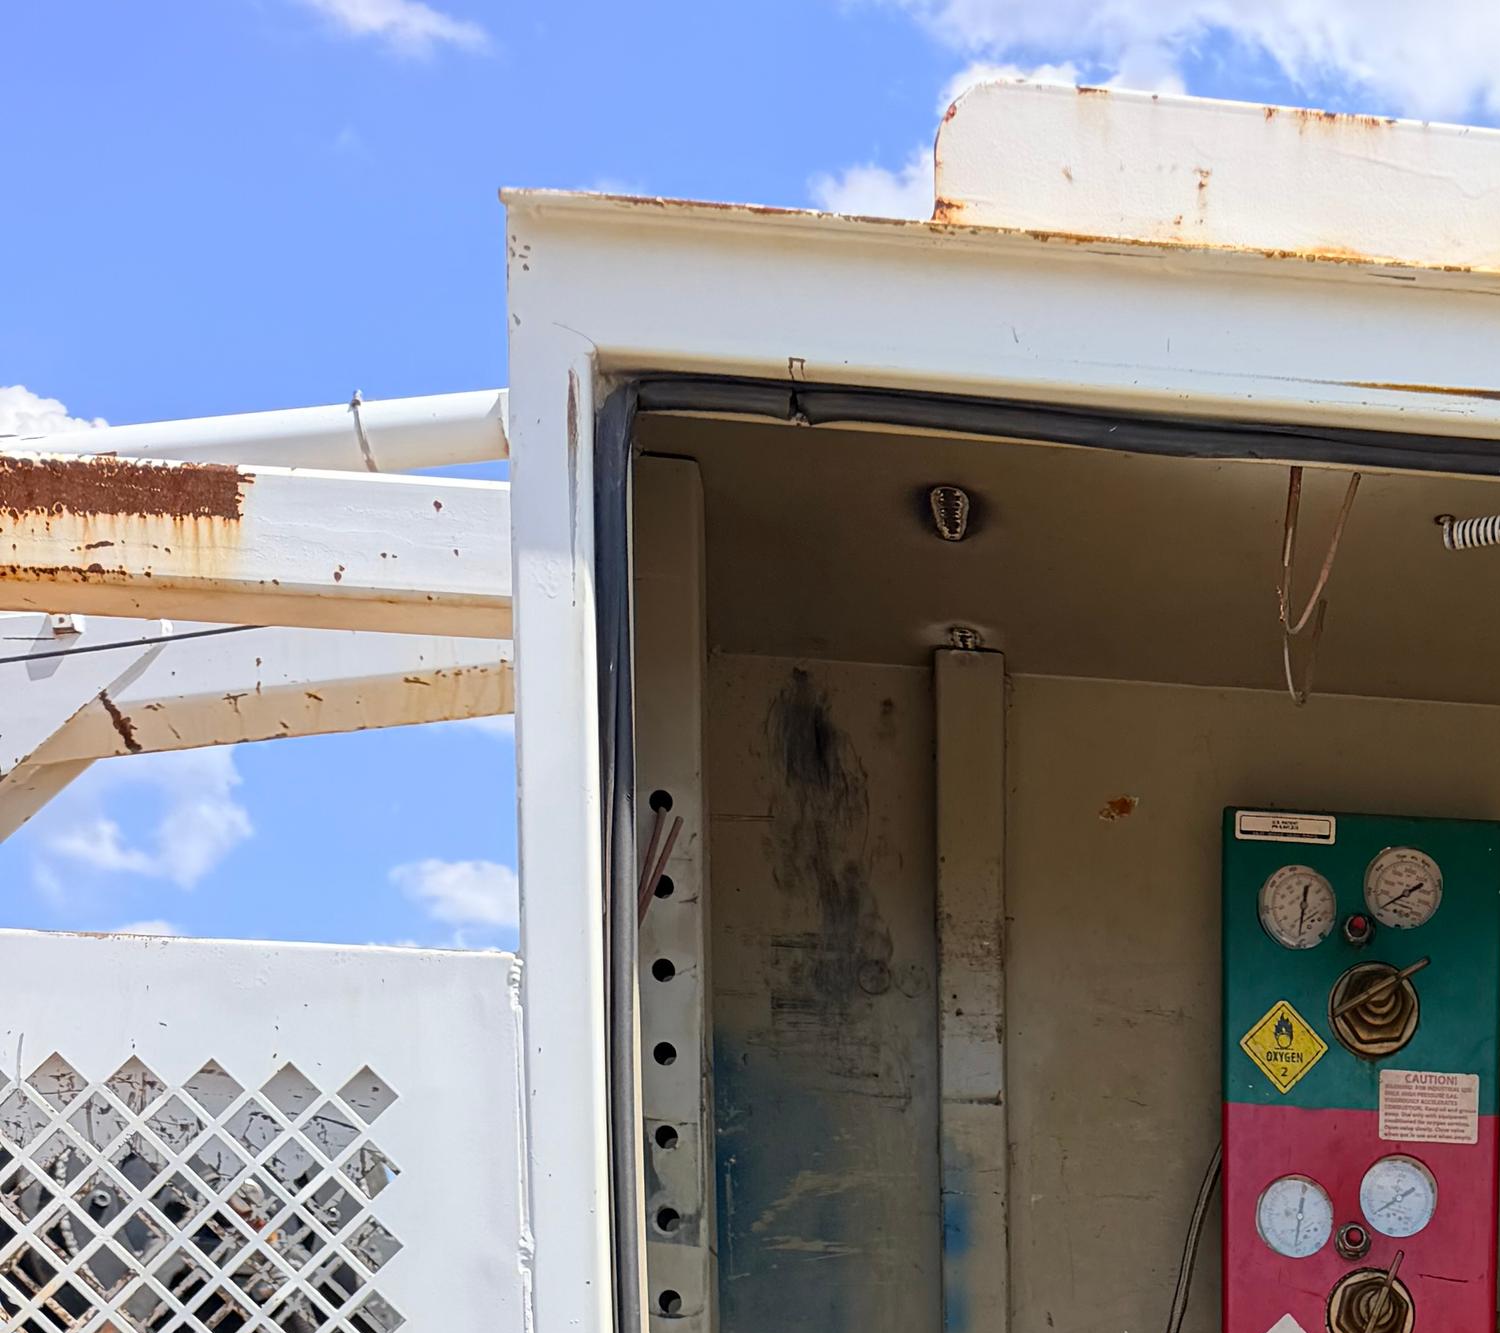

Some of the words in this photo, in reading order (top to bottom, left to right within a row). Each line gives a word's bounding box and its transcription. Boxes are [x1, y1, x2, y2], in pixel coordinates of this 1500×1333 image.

[1266, 1051, 1304, 1063] OXYGEN
[1281, 1067, 1289, 1077] 2
[1405, 1074, 1458, 1085] CAUTION!
